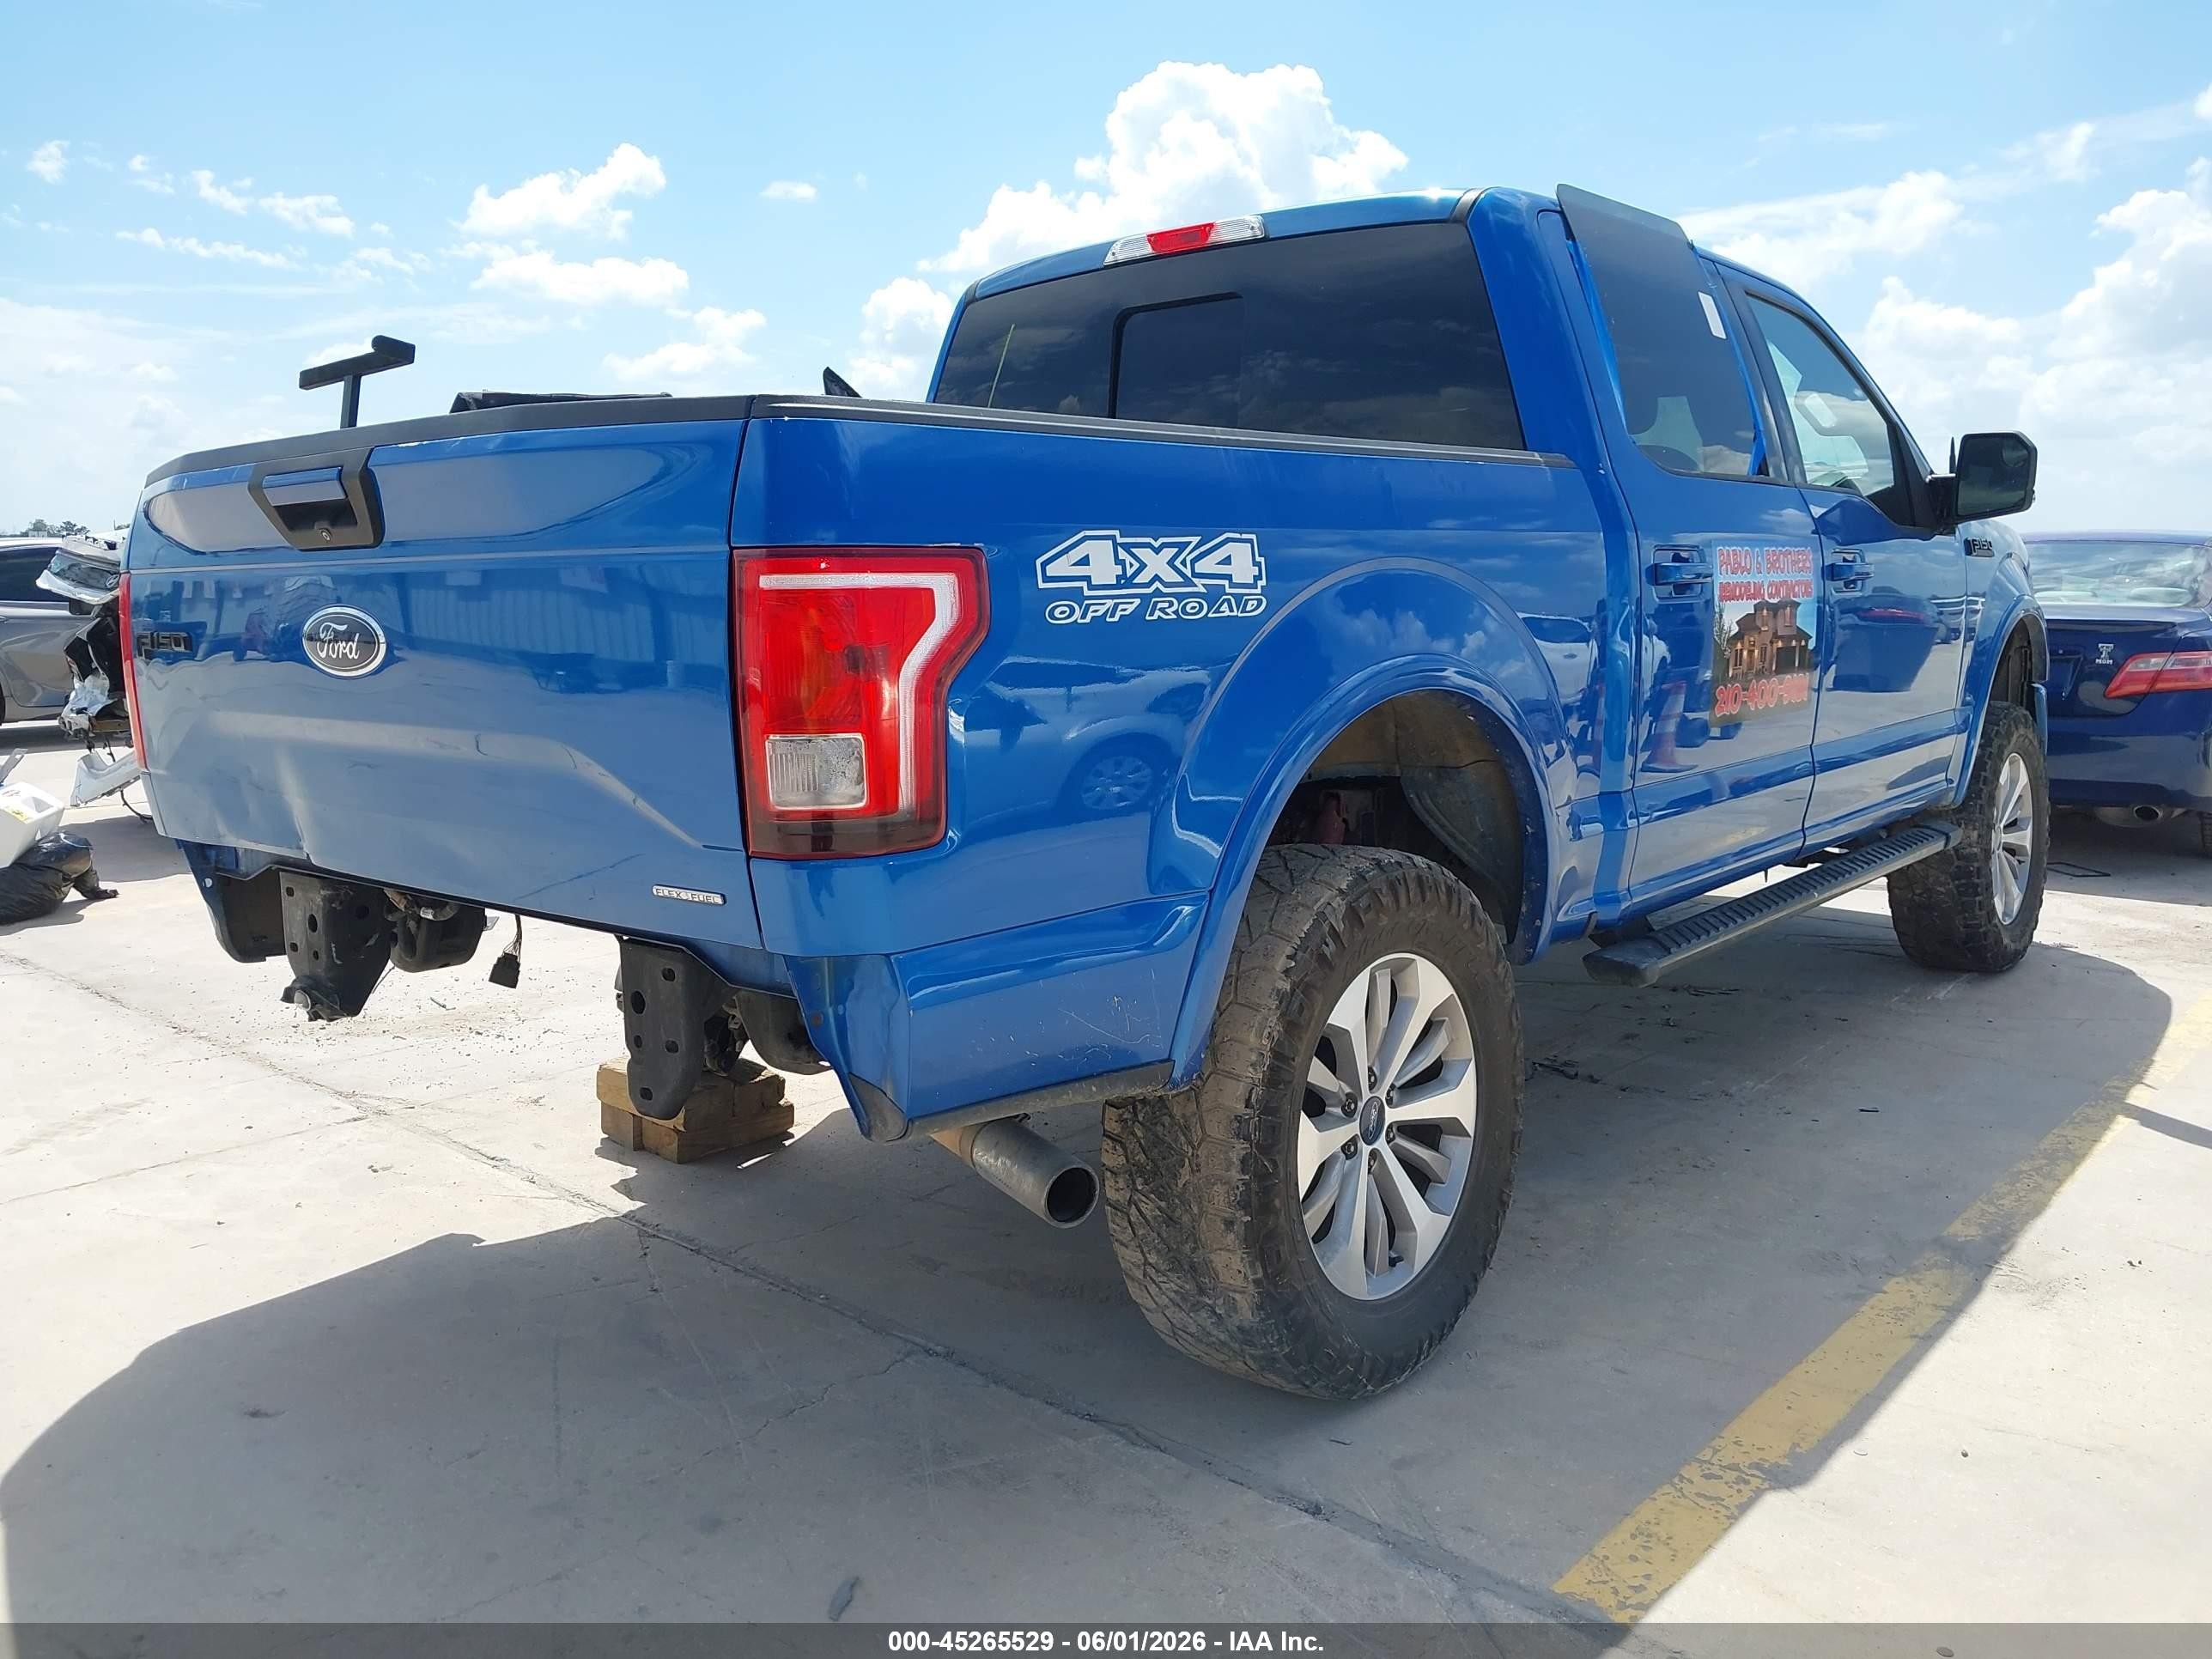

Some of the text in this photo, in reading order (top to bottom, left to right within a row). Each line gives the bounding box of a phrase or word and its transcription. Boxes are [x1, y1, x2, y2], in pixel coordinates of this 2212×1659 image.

[1717, 547, 1814, 576] PABLO & BROTHERS
[1045, 595, 1267, 624] OFF ROAD
[316, 621, 361, 660] Ford
[655, 888, 720, 904] FLEX FUEL
